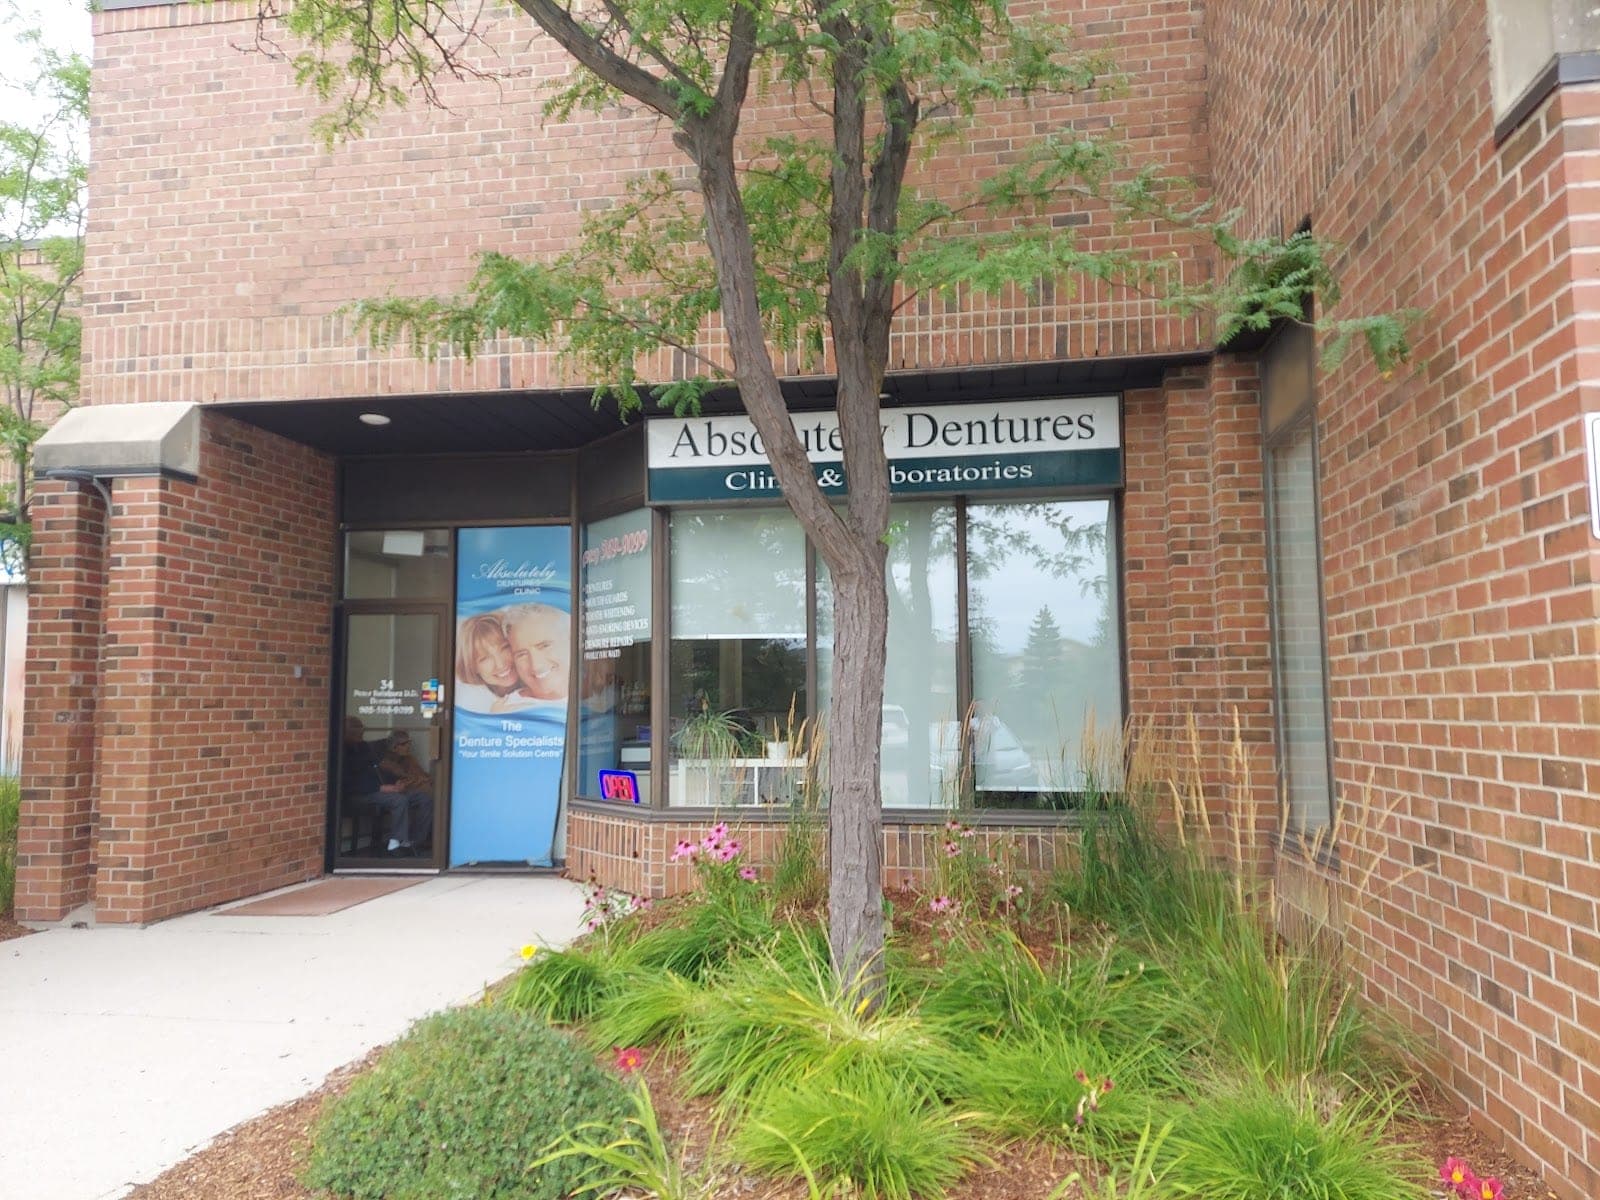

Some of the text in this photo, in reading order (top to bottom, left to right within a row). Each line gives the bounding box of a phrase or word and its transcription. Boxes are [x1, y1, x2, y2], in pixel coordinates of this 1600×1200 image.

[904, 411, 1097, 449] Dentures
[817, 468, 844, 487] &
[889, 461, 1034, 484] boratories
[472, 558, 557, 580] Absolutely
[514, 587, 541, 595] CLINIC
[380, 680, 394, 689] 34
[501, 719, 522, 731] The
[459, 734, 564, 748] Denture Specialists
[480, 749, 501, 758] Smile
[503, 749, 533, 758] Solution
